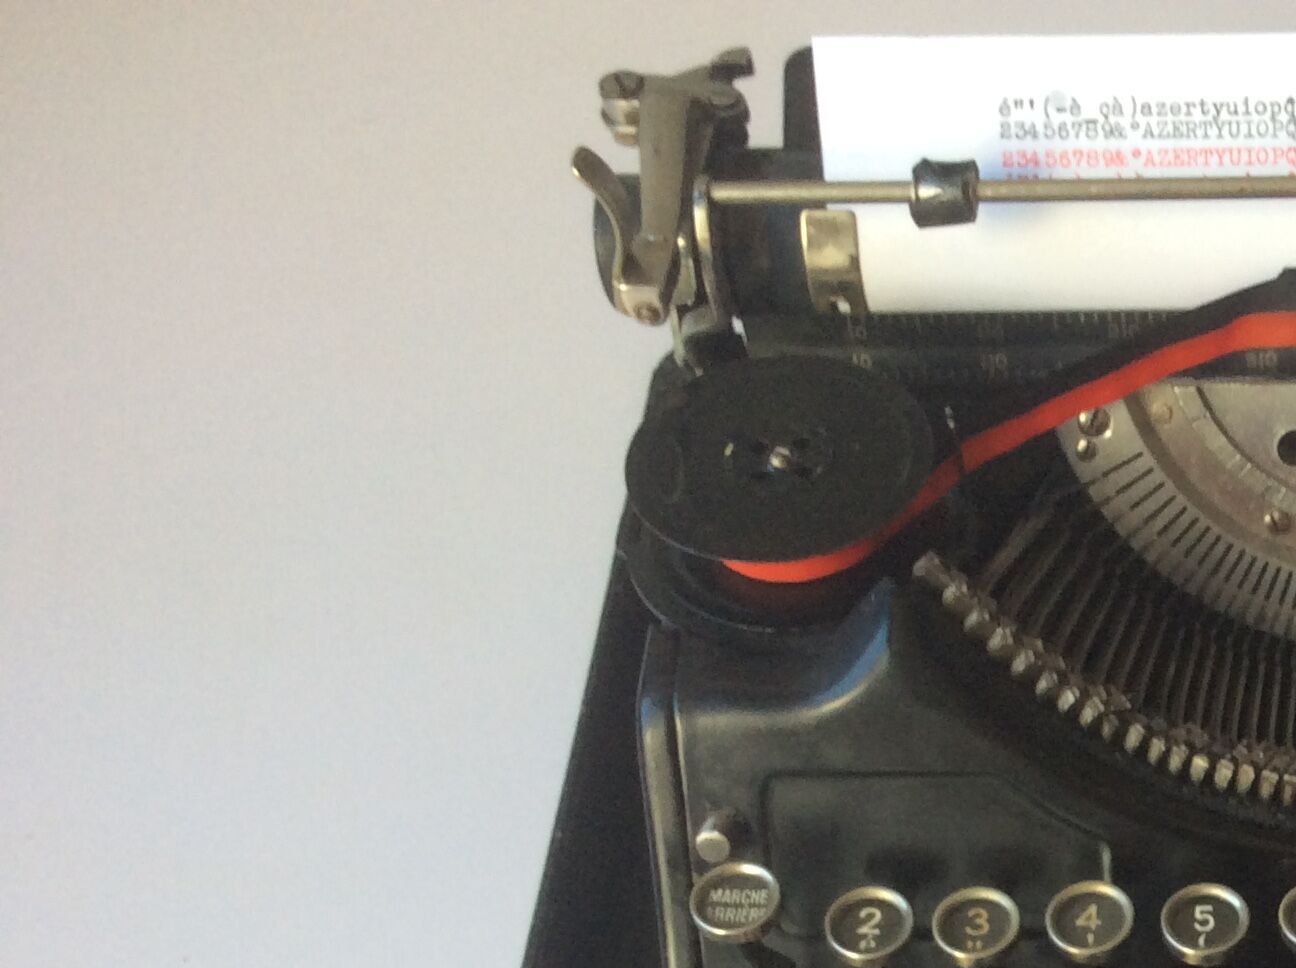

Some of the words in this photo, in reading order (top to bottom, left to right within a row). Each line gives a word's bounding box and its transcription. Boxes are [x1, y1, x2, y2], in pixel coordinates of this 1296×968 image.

[709, 888, 768, 904] MARCHE
[856, 907, 882, 935] 2
[967, 907, 990, 936] 3
[1075, 903, 1101, 930] 4
[1193, 905, 1216, 933] 5
